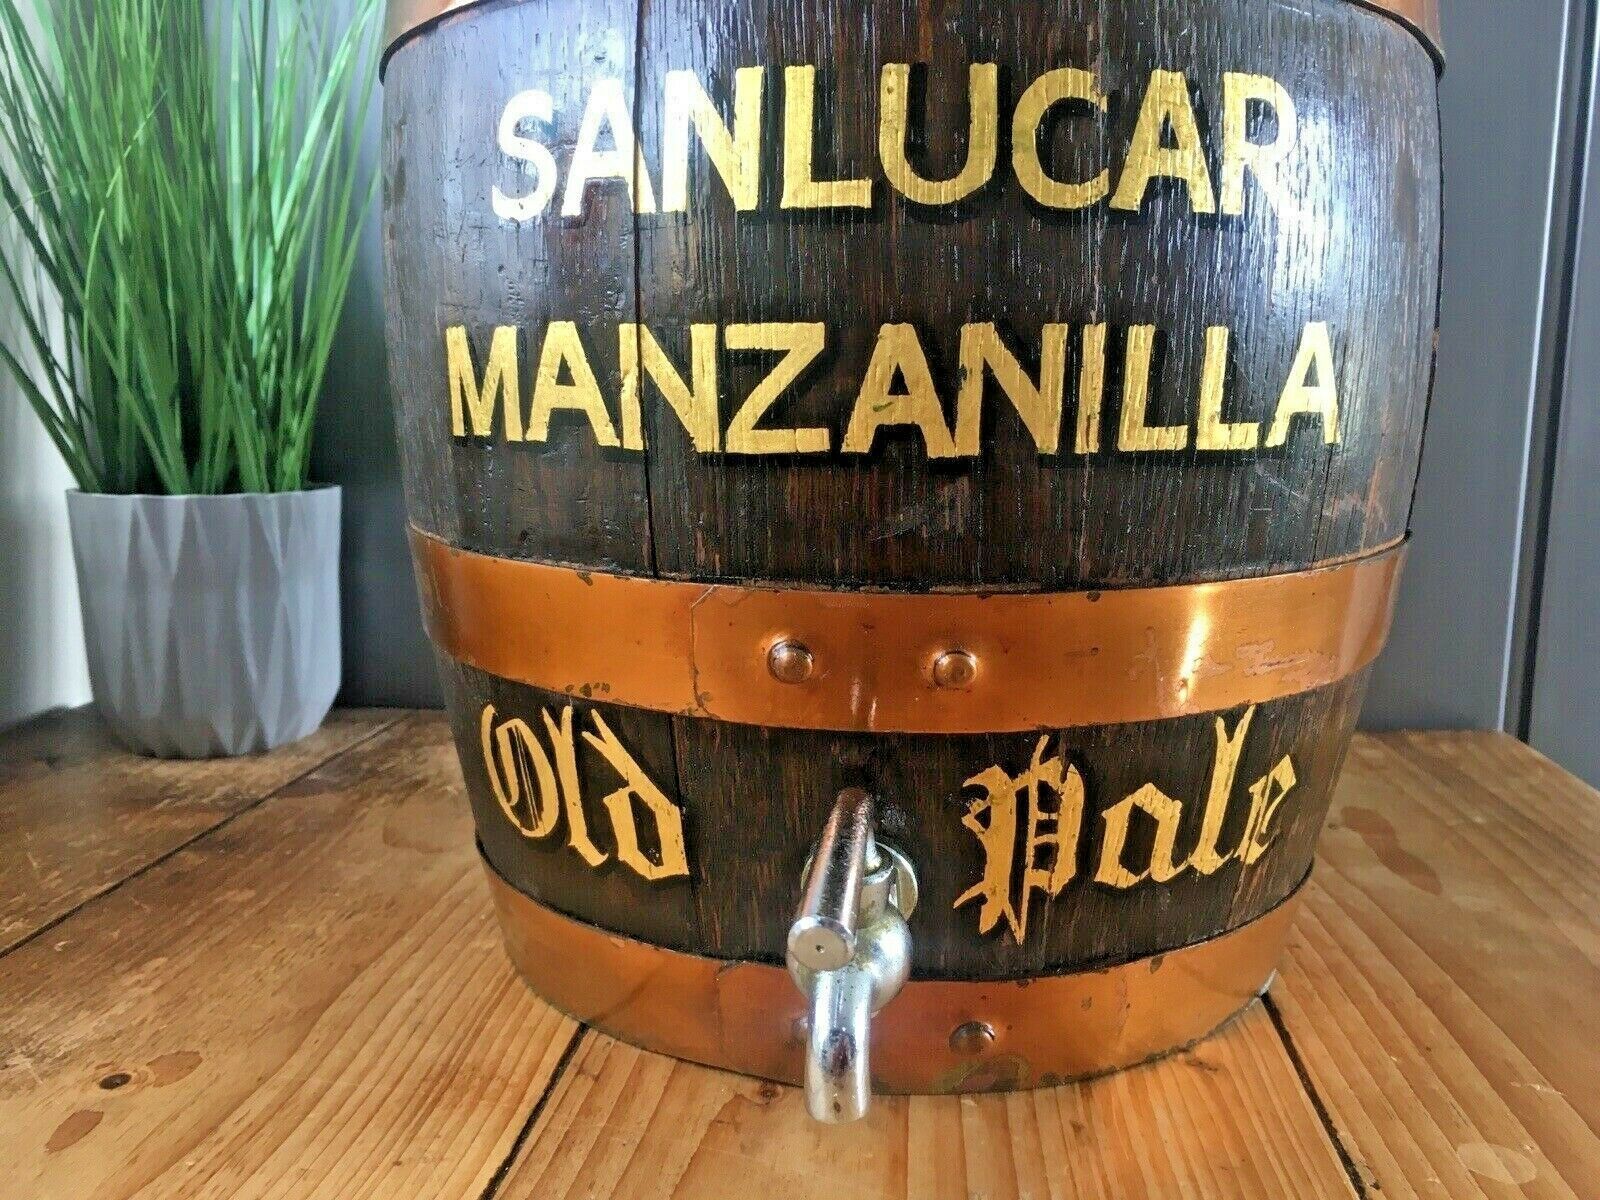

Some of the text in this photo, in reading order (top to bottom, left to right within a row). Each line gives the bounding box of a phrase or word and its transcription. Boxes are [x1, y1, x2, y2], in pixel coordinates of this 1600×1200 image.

[491, 62, 1302, 221] SANLUCAR
[446, 320, 1342, 459] MANZANILLA
[481, 704, 1297, 945] Old Pale
